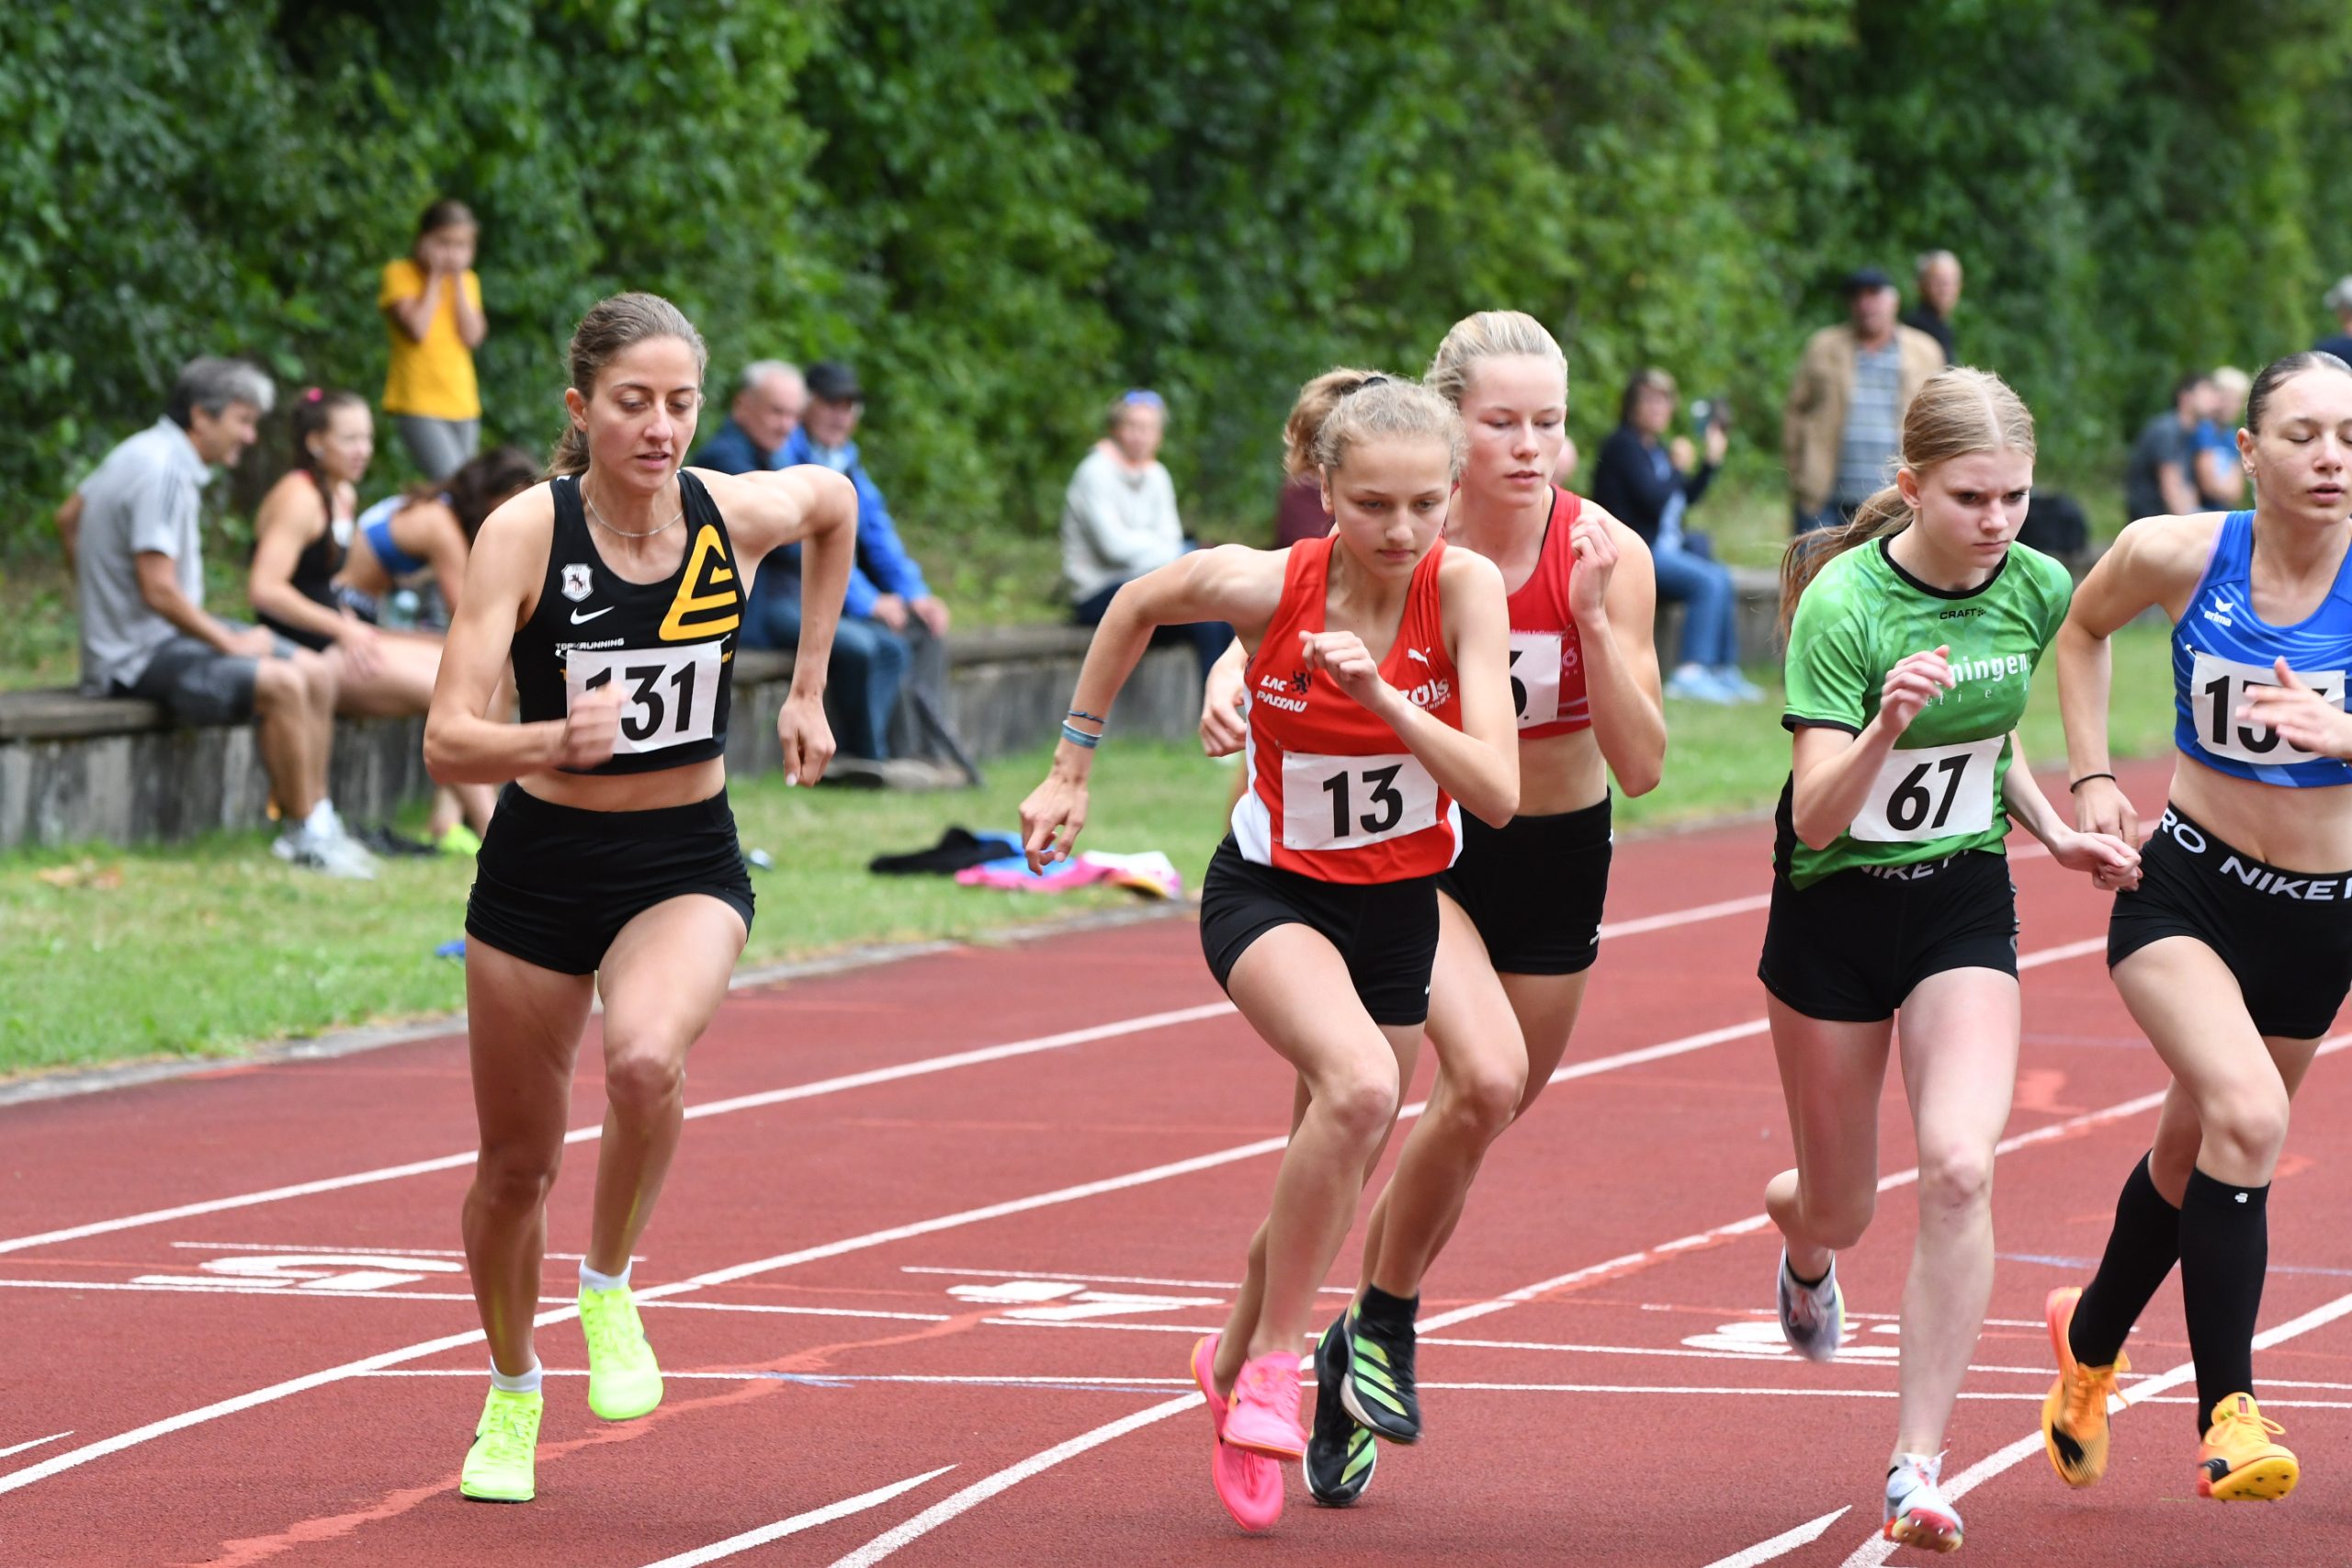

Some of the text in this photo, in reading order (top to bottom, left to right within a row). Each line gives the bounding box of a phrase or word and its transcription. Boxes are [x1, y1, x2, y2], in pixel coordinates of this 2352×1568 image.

[1939, 608, 1977, 620] CRAFT
[2204, 610, 2233, 627] erima
[1261, 674, 1287, 692] LAC
[1936, 653, 2028, 685] ningen
[1256, 689, 1308, 713] PASSAU
[1322, 763, 1403, 839] 13
[1886, 753, 1973, 831] 67
[2219, 855, 2339, 900] NIKE
